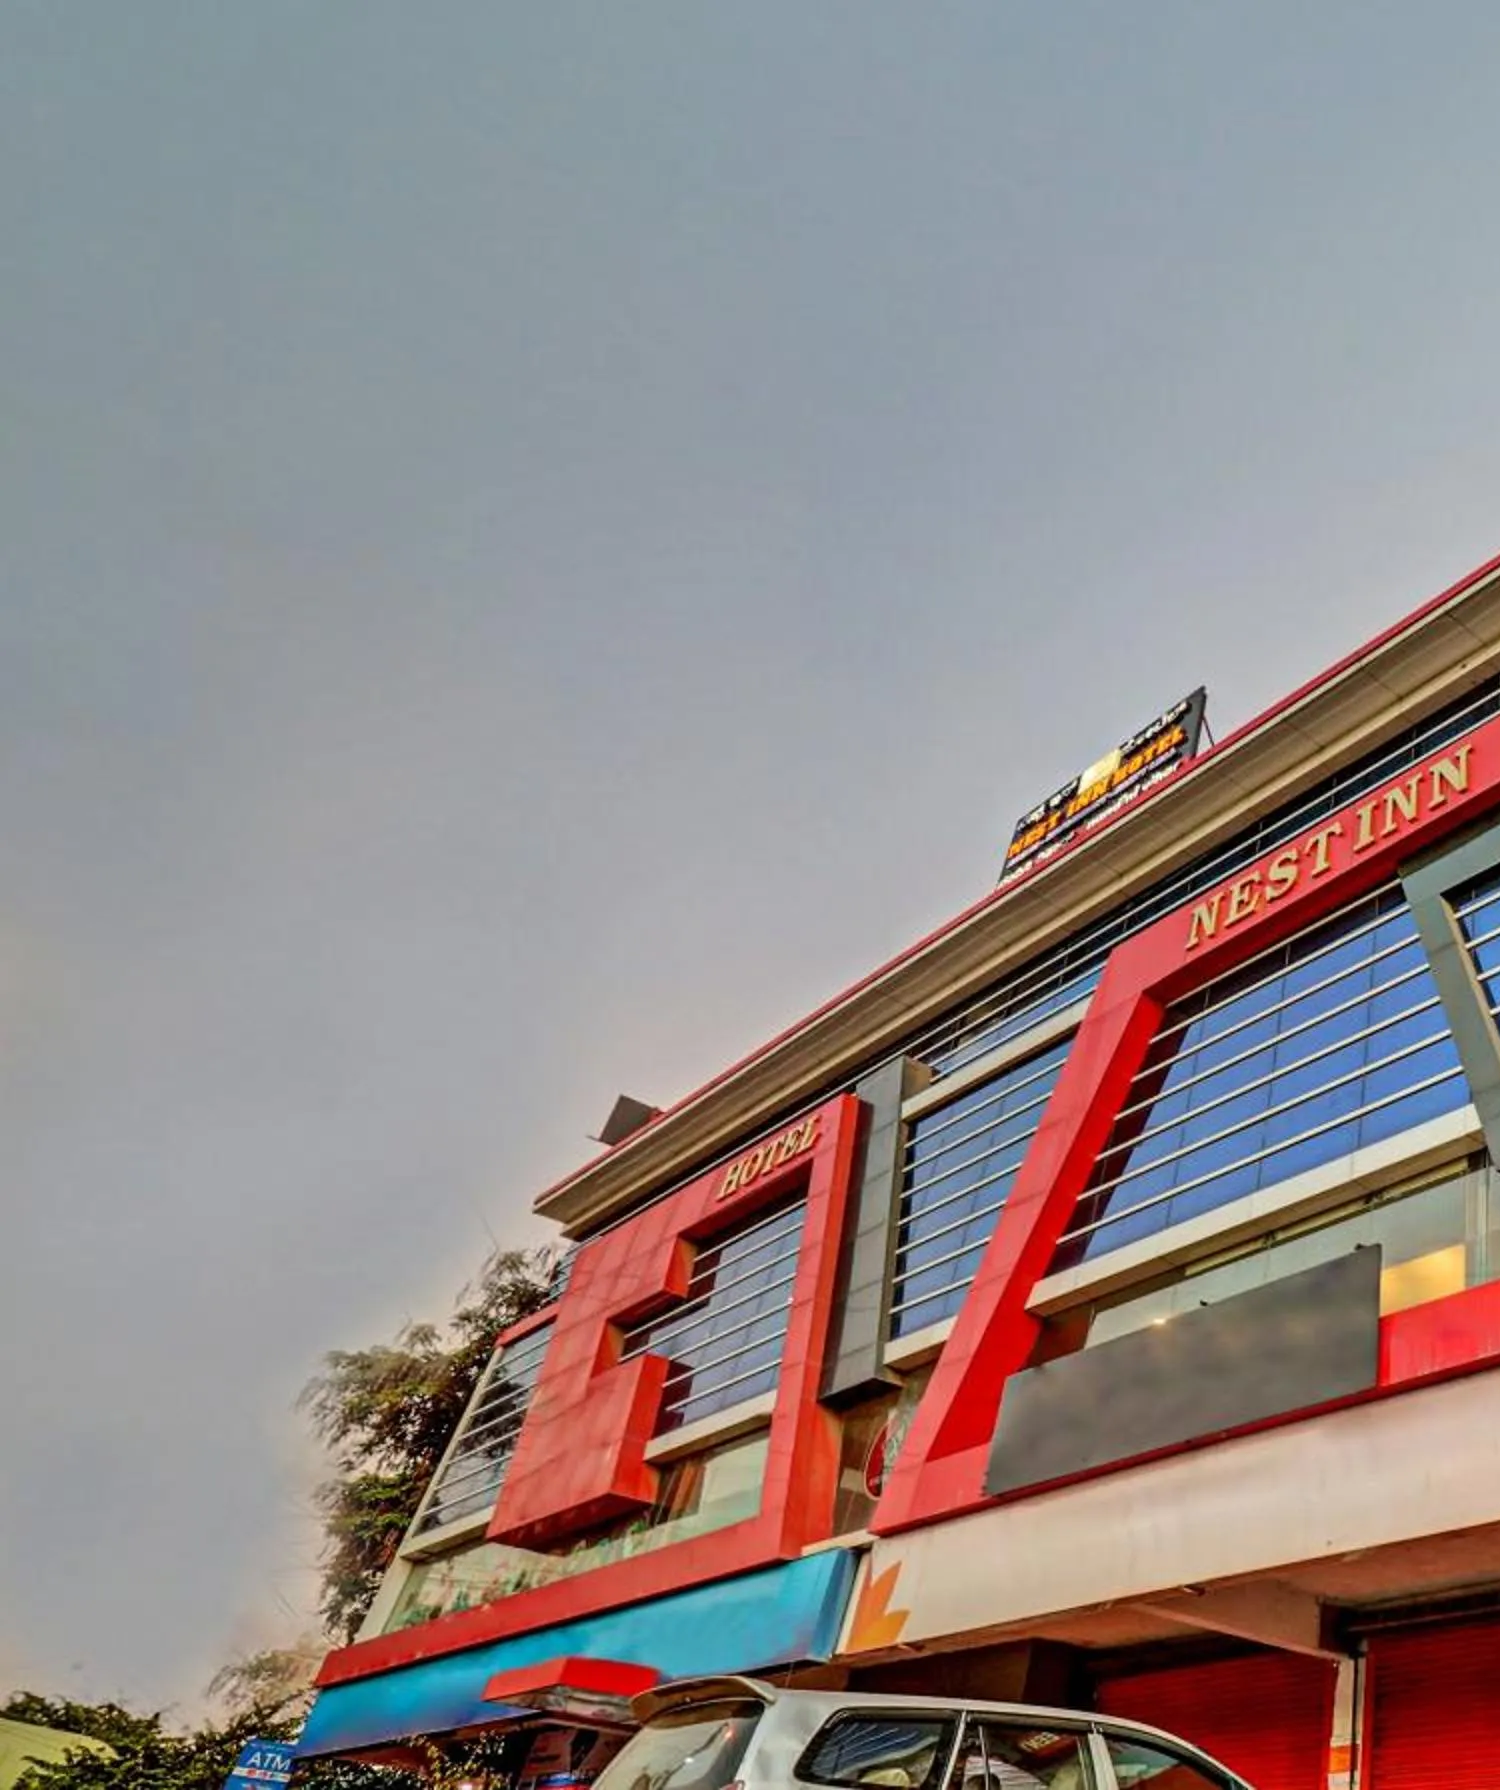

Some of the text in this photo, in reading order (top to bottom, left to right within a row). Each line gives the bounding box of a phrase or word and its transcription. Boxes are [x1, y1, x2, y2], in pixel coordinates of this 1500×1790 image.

[1185, 822, 1344, 951] NEST
[1352, 742, 1476, 855] INN
[715, 1113, 824, 1202] HOTEL
[246, 1750, 292, 1771] ATM
